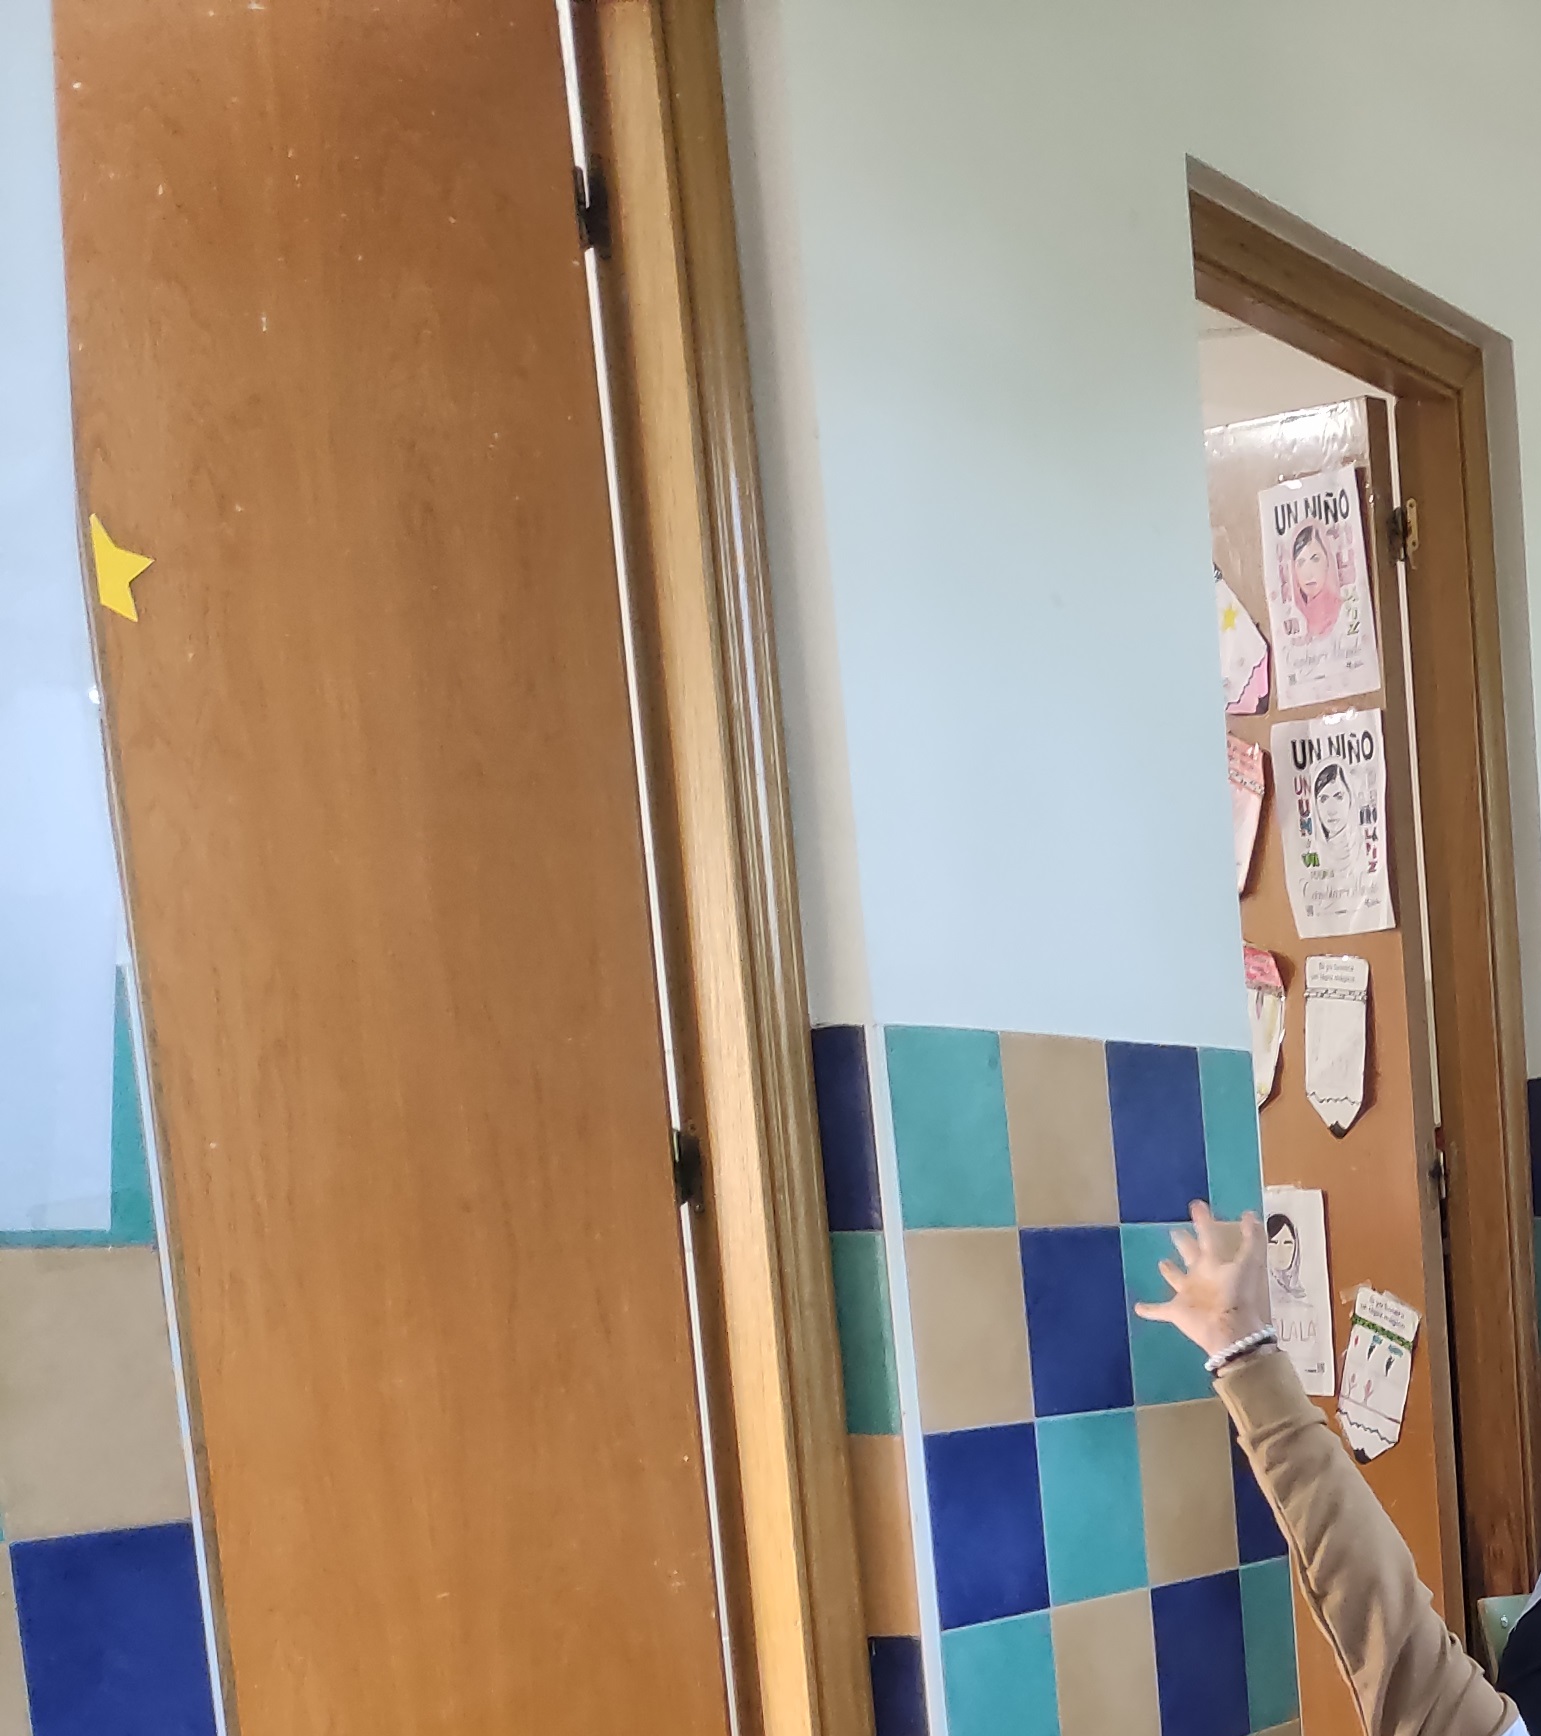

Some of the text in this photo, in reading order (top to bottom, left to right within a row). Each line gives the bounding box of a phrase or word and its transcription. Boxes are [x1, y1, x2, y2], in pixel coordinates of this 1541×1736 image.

[1274, 488, 1350, 536] UN NIÑO
[1290, 736, 1322, 771] UN
[1327, 729, 1375, 766] NIÑO
